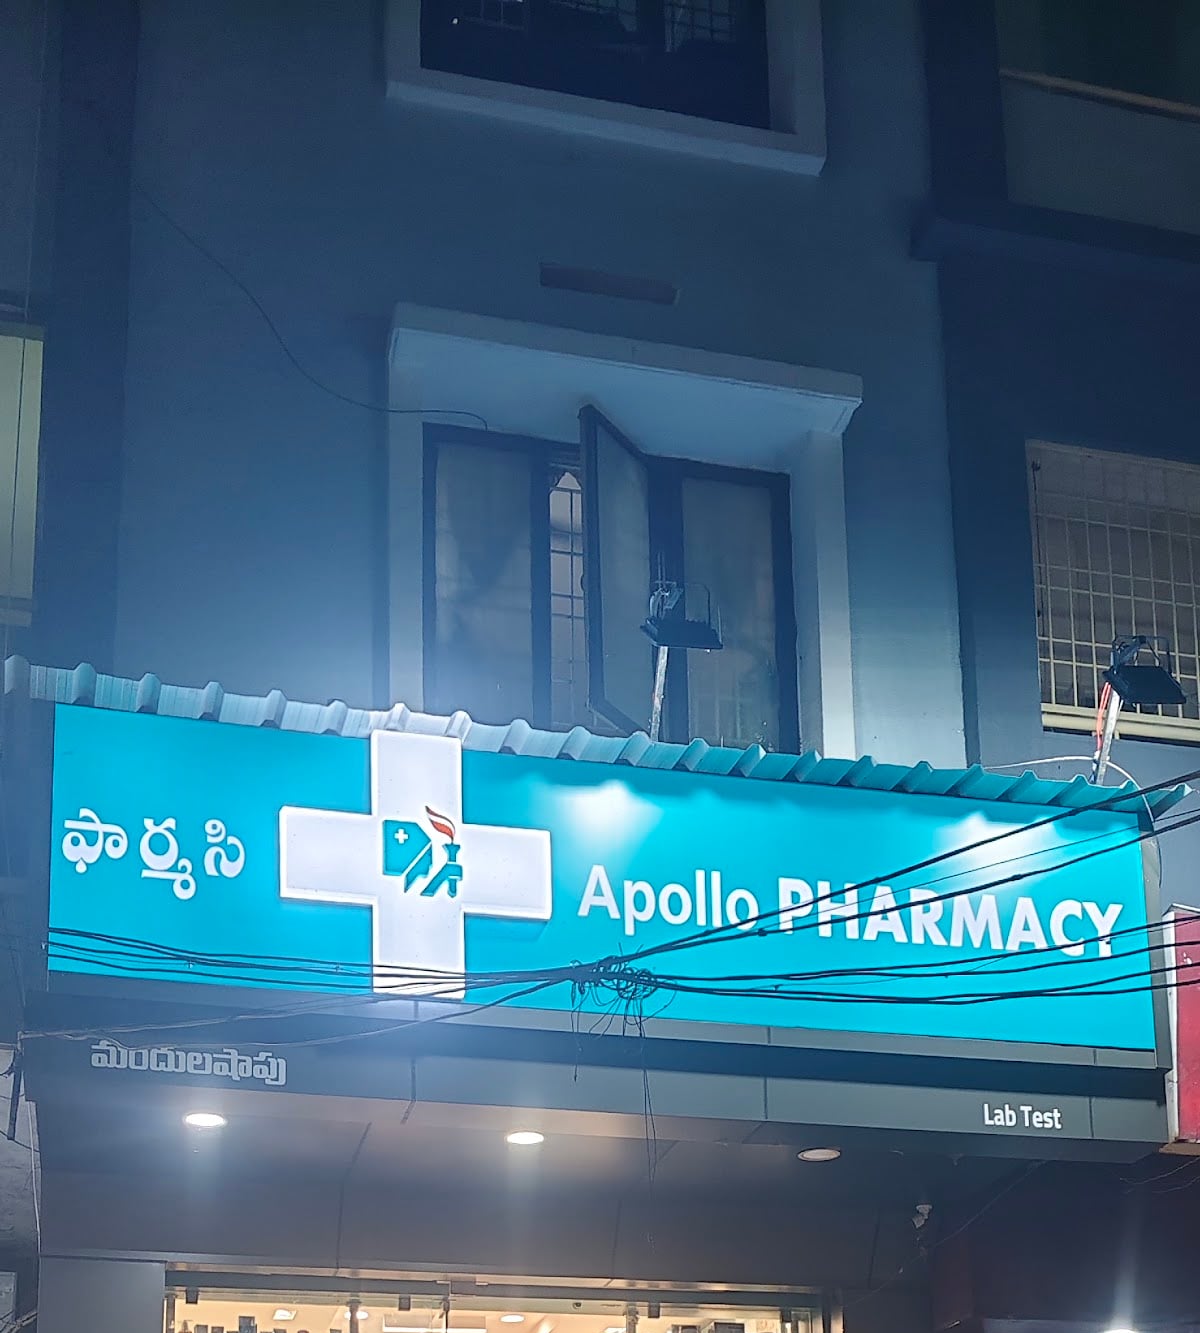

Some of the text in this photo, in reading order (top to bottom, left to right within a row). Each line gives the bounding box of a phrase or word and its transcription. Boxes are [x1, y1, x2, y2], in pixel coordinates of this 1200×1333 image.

[577, 864, 1124, 958] Apollo PHARMACY
[90, 1040, 287, 1086] మందులషాపు
[983, 1102, 1062, 1130] Lab Test
